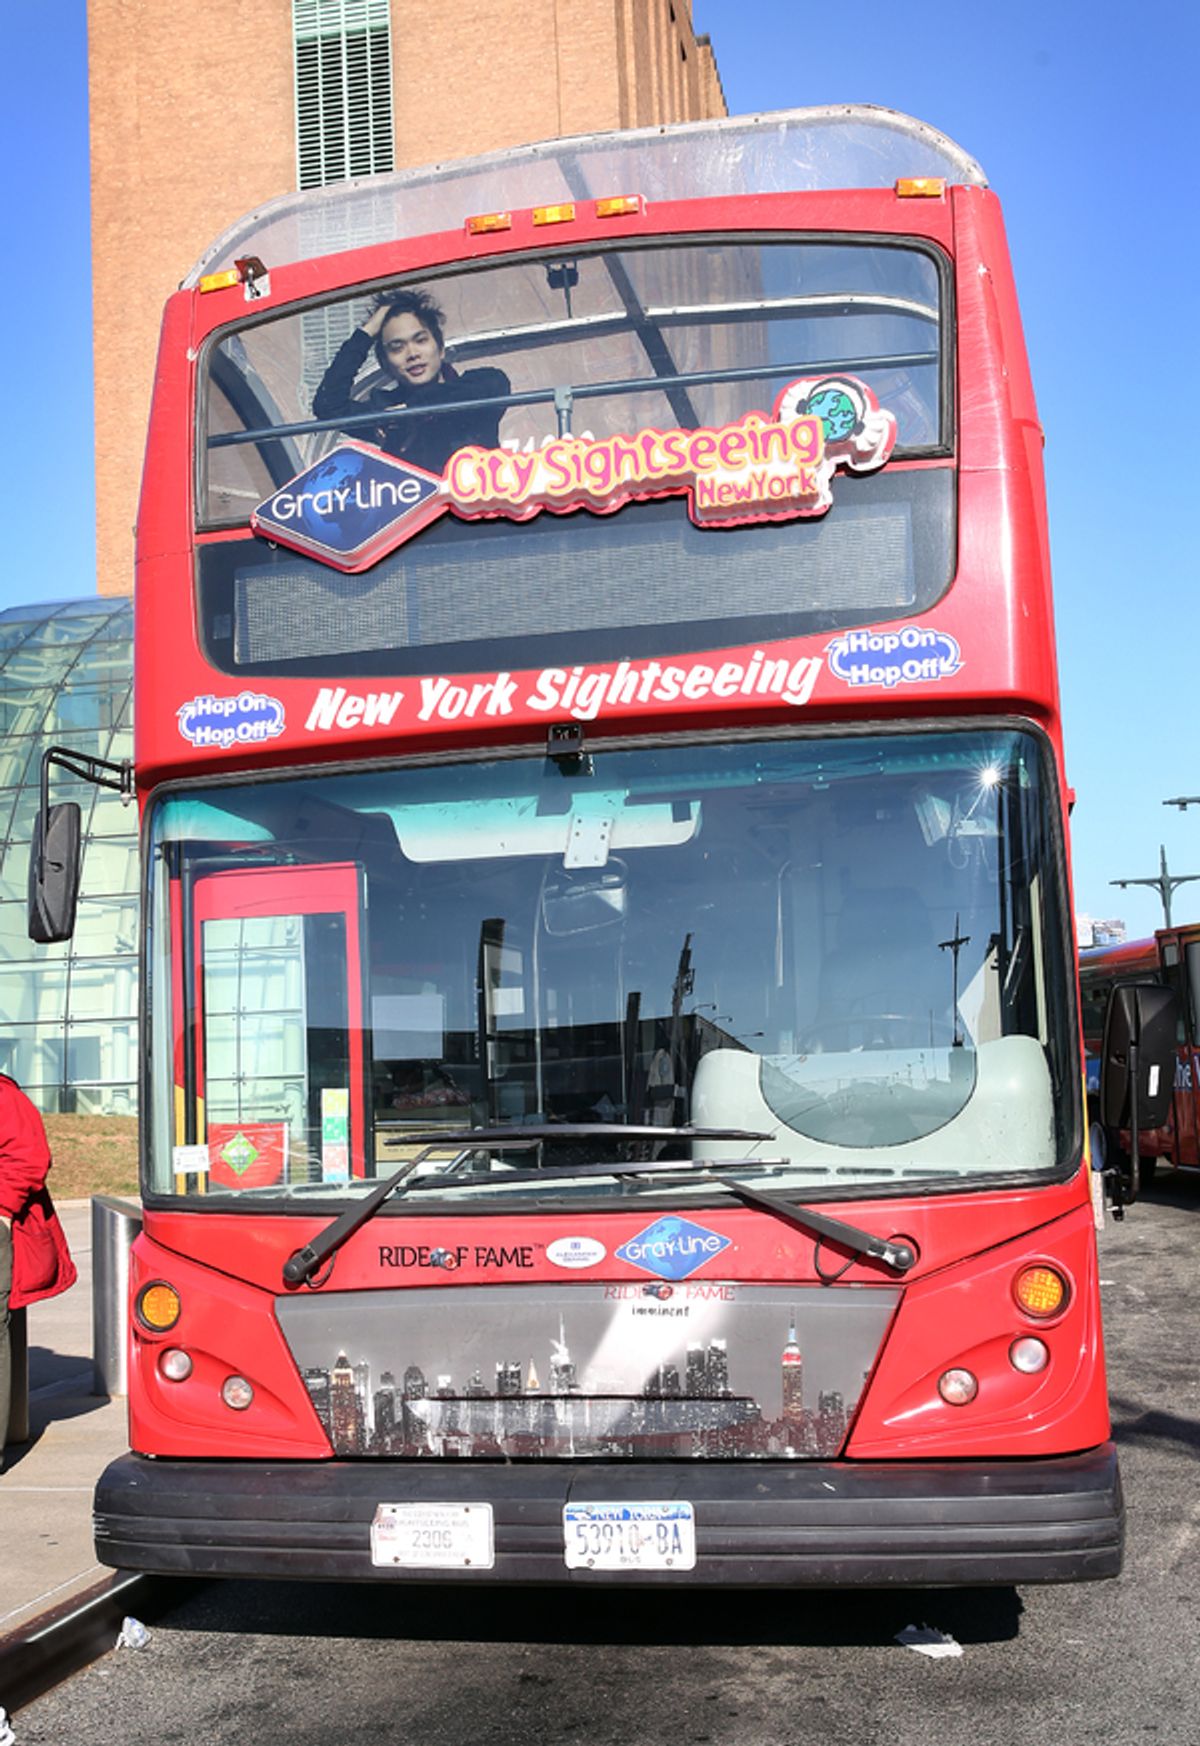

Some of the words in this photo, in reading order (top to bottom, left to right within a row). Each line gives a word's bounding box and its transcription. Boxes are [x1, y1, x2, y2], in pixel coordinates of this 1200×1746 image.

[305, 686, 404, 731] New
[417, 672, 517, 720] York
[526, 650, 822, 720] Sightseeing
[379, 1246, 430, 1267] RIDE
[475, 1246, 535, 1267] FAME
[686, 1285, 736, 1300] FAME
